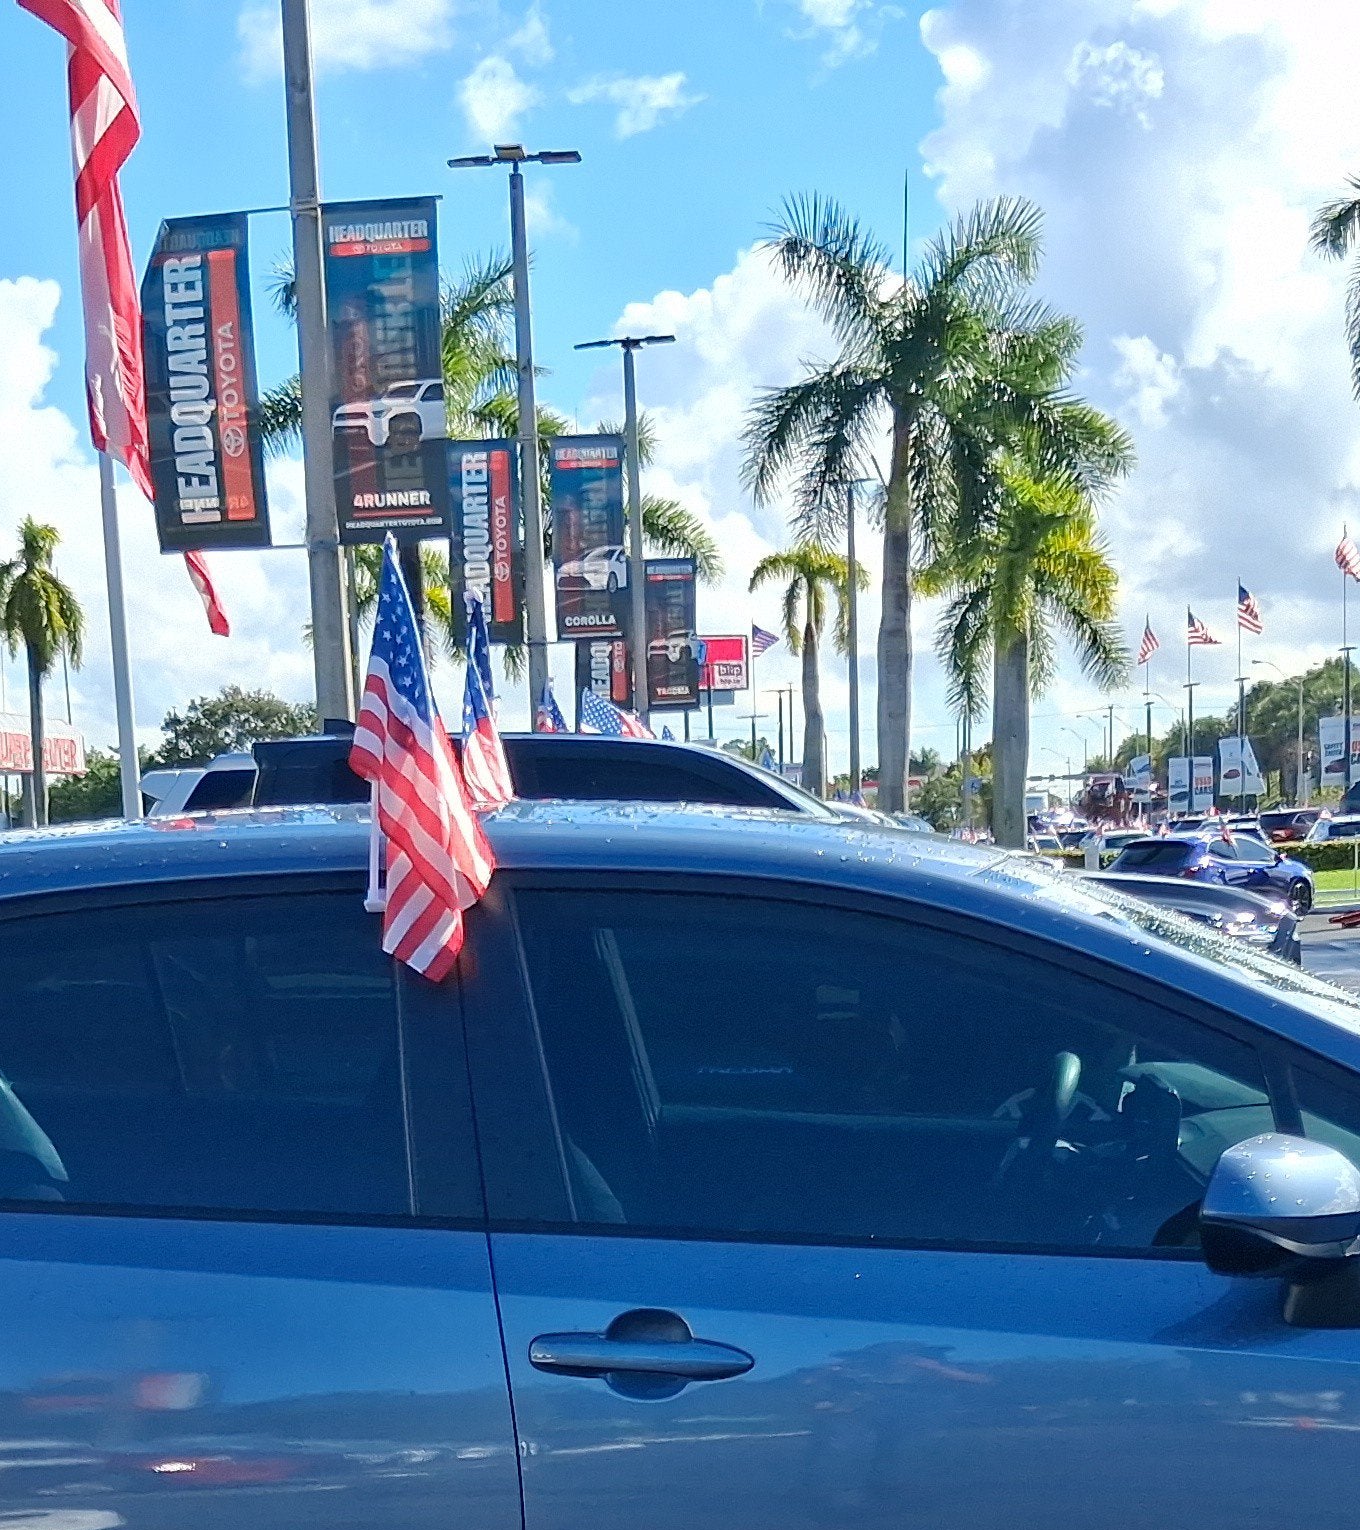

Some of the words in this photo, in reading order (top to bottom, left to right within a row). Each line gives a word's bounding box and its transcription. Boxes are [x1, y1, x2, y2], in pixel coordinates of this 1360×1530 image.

[328, 220, 428, 242] HEADQUARTER
[163, 254, 222, 524] HEADQUARTER
[217, 321, 241, 421] TOYOTA
[353, 490, 431, 508] 4RUNNER
[461, 451, 493, 624] ADQUARTER
[494, 495, 508, 558] TOYOTA
[564, 614, 617, 626] COROLLA
[720, 664, 741, 677] blip
